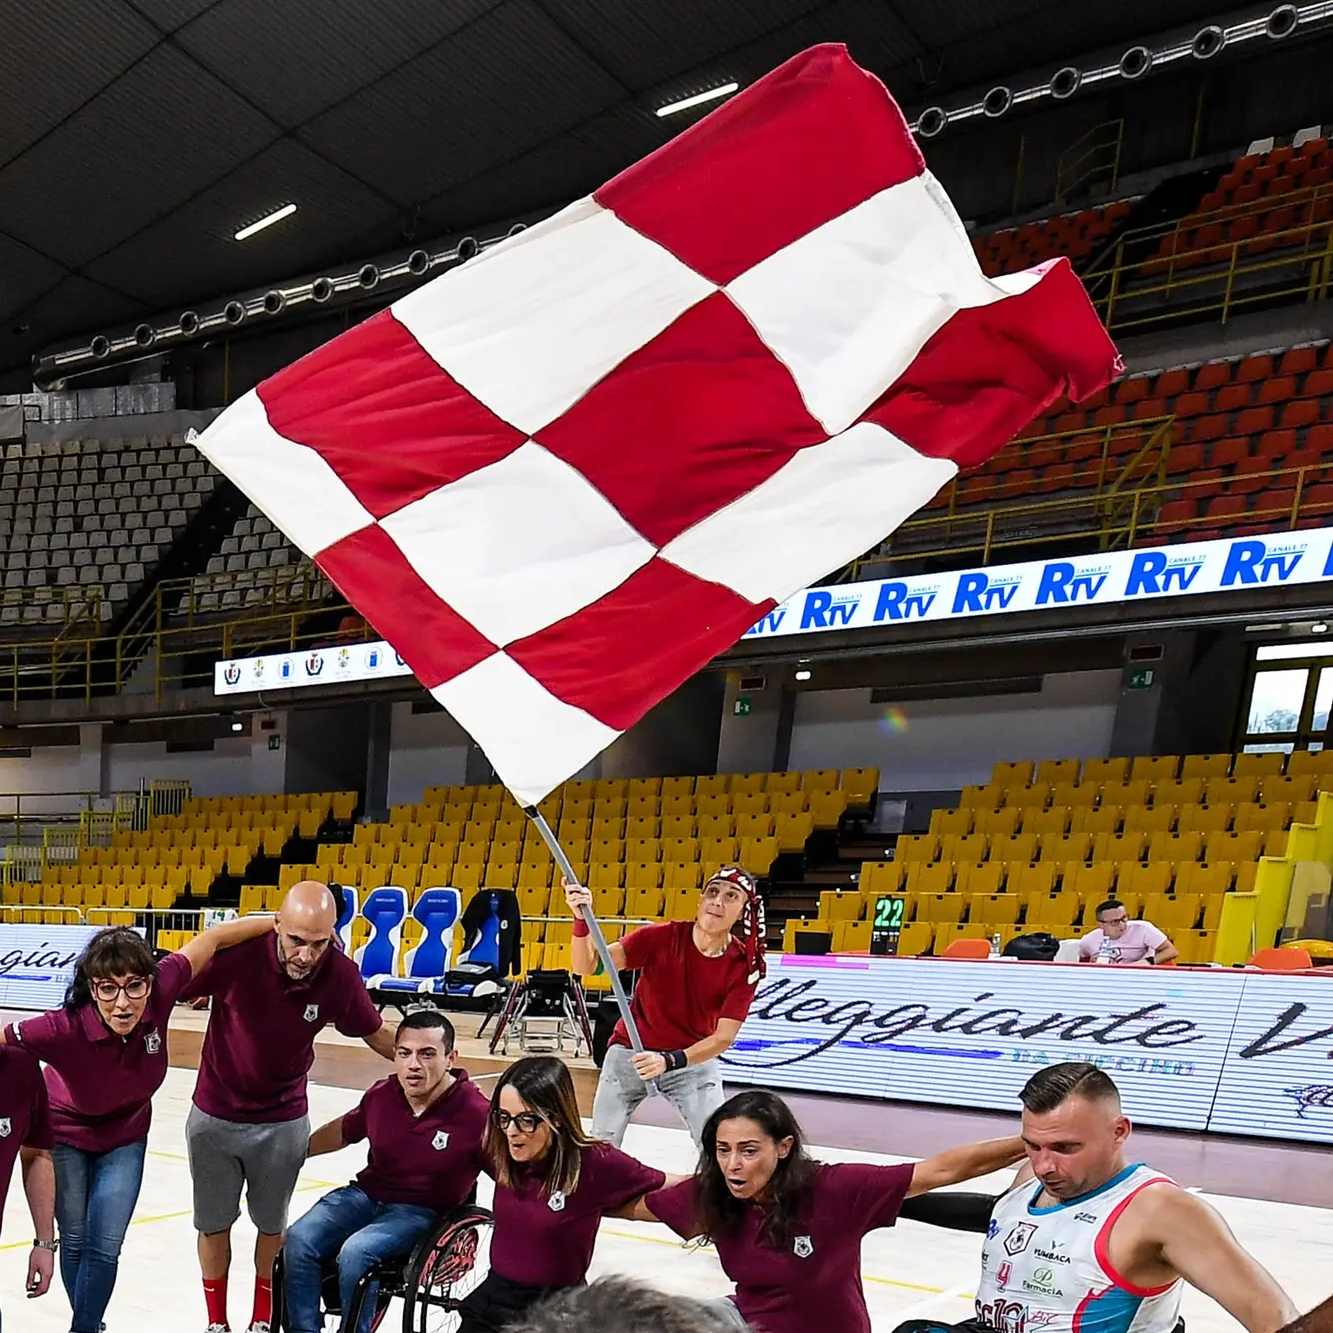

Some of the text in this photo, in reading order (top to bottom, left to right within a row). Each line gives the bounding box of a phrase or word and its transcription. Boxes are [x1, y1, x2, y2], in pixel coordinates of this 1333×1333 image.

[1268, 545, 1297, 553] CANALE
[1168, 556, 1196, 564] CANALE
[875, 899, 904, 927] 22
